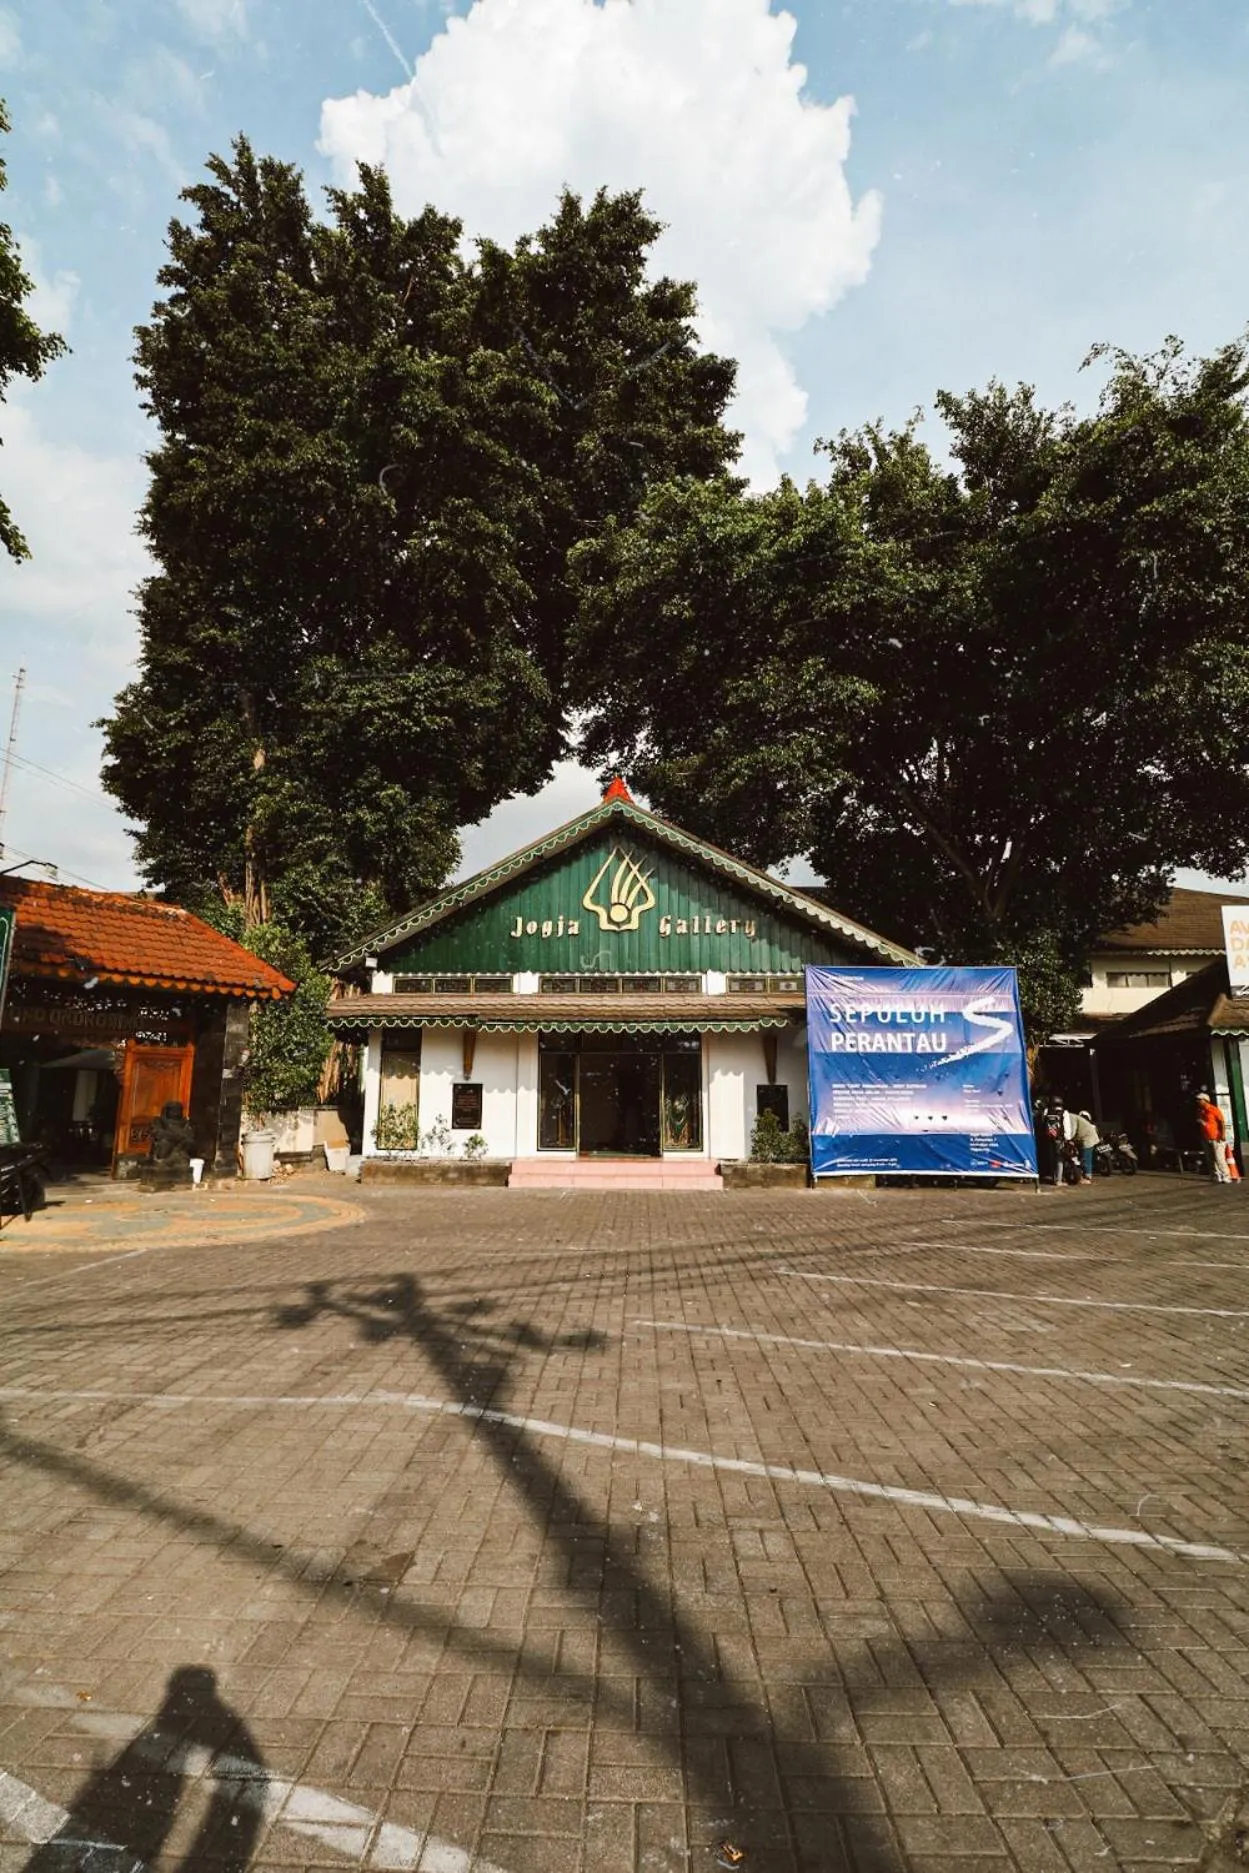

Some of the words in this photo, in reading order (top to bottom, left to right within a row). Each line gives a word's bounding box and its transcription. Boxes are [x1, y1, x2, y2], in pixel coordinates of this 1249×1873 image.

[510, 914, 580, 939] Jogja
[659, 914, 757, 938] Gallery
[829, 1003, 946, 1024] SEPULUH
[831, 1032, 948, 1053] PERANTAU
